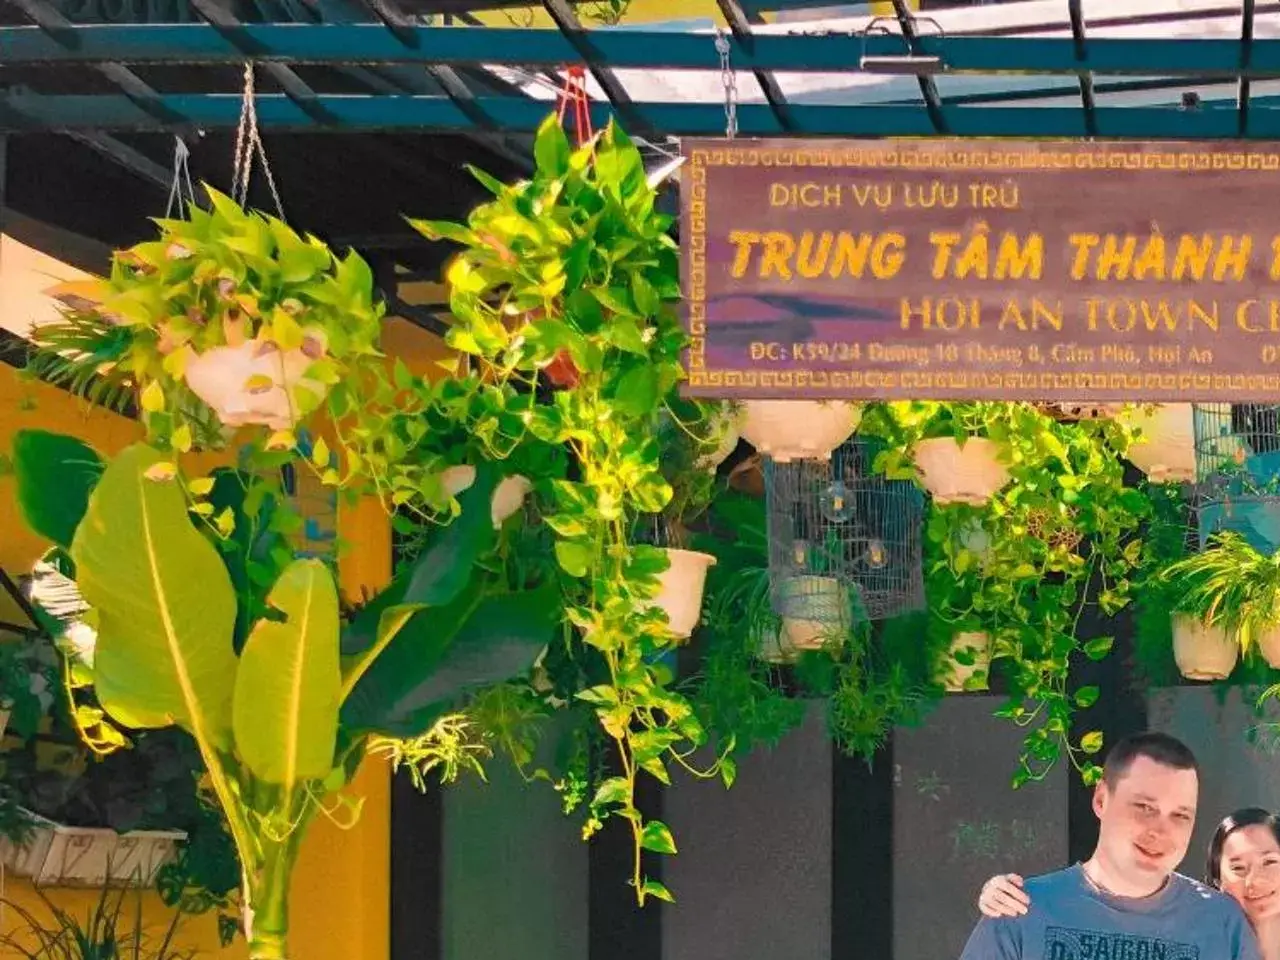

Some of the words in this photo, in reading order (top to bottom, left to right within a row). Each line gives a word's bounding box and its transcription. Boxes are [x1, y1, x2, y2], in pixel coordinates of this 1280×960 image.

[728, 229, 906, 281] TRUNG
[929, 218, 1045, 281] TÂM
[1068, 218, 1252, 282] THÀNH
[900, 296, 981, 331] HOI
[998, 296, 1064, 331] AN
[1085, 296, 1220, 332] TOWN
